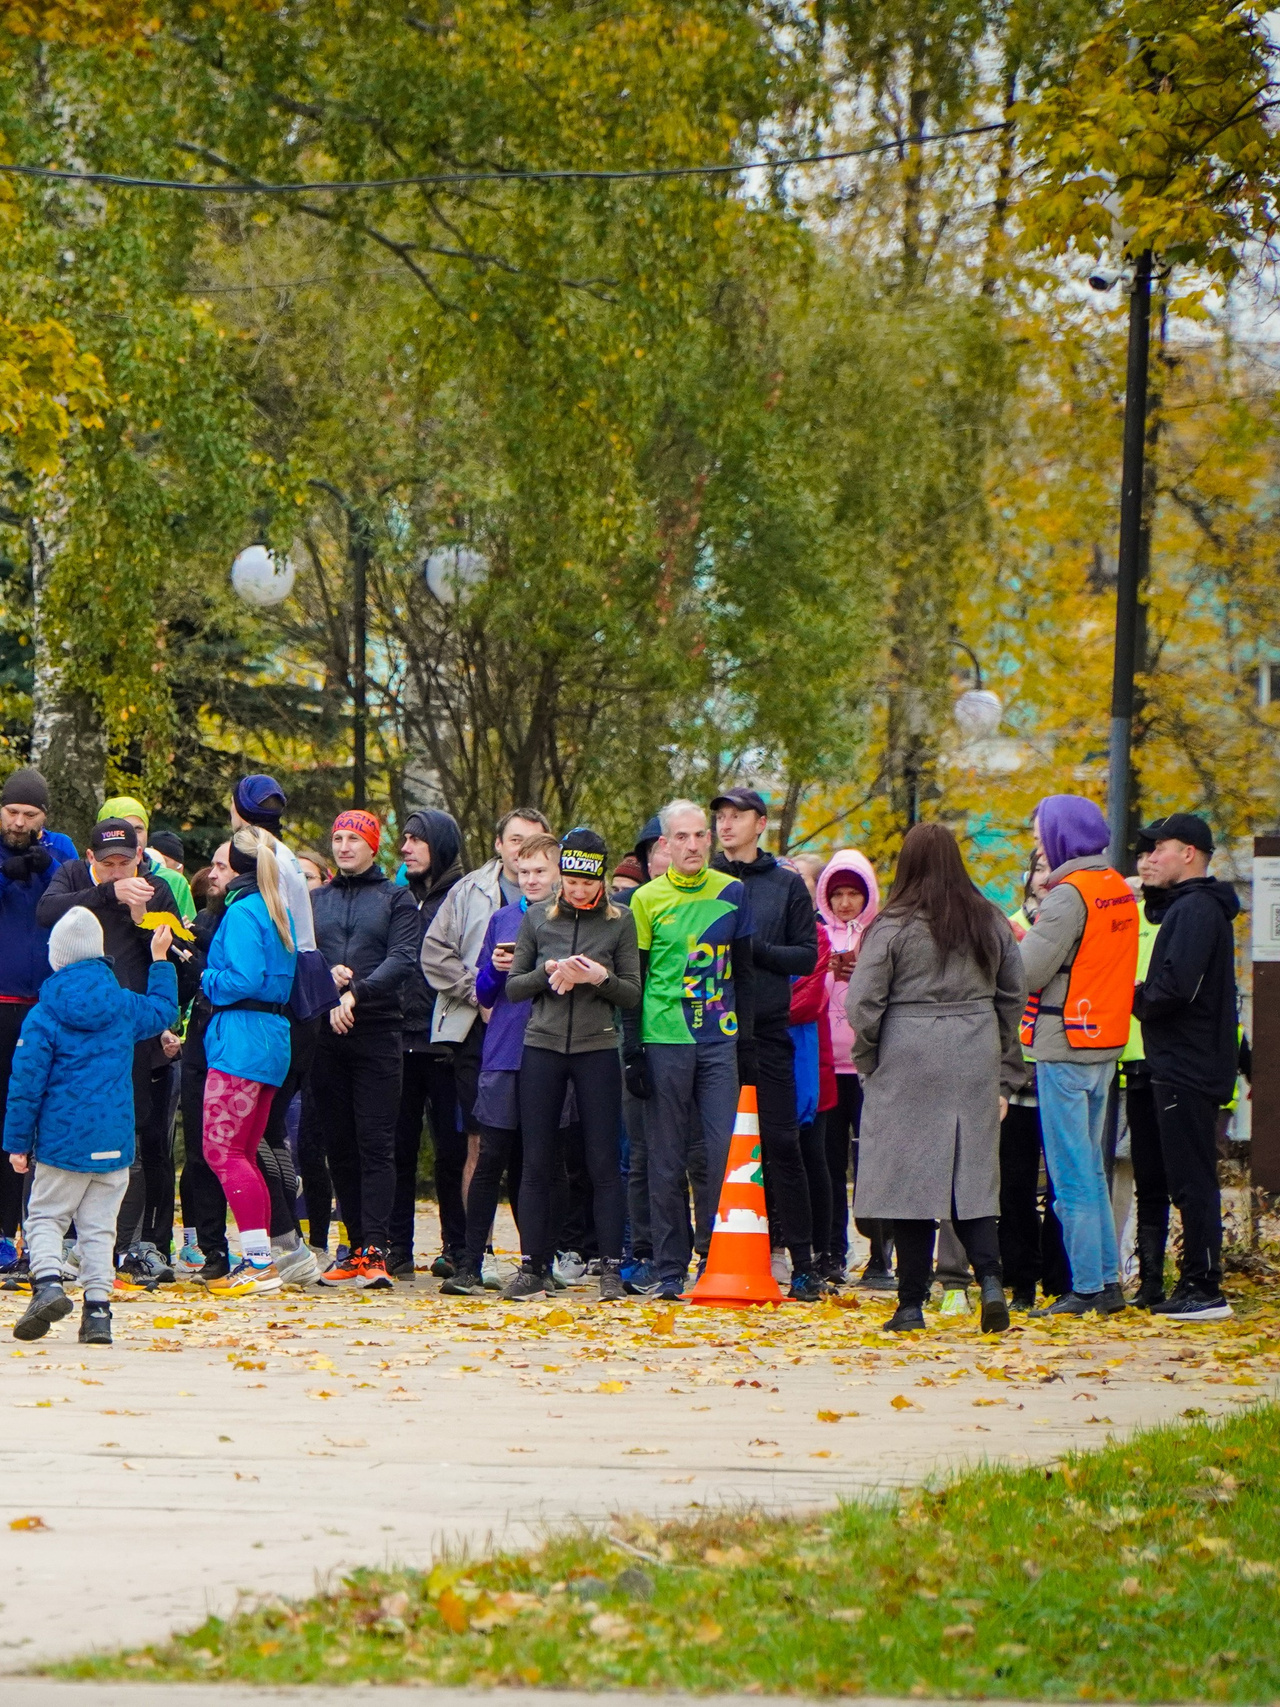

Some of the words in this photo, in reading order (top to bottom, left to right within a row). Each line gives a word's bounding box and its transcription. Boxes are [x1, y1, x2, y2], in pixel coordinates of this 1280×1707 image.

[101, 830, 125, 839] YOUFC
[561, 855, 603, 873] TODAY
[691, 1001, 704, 1029] trail
